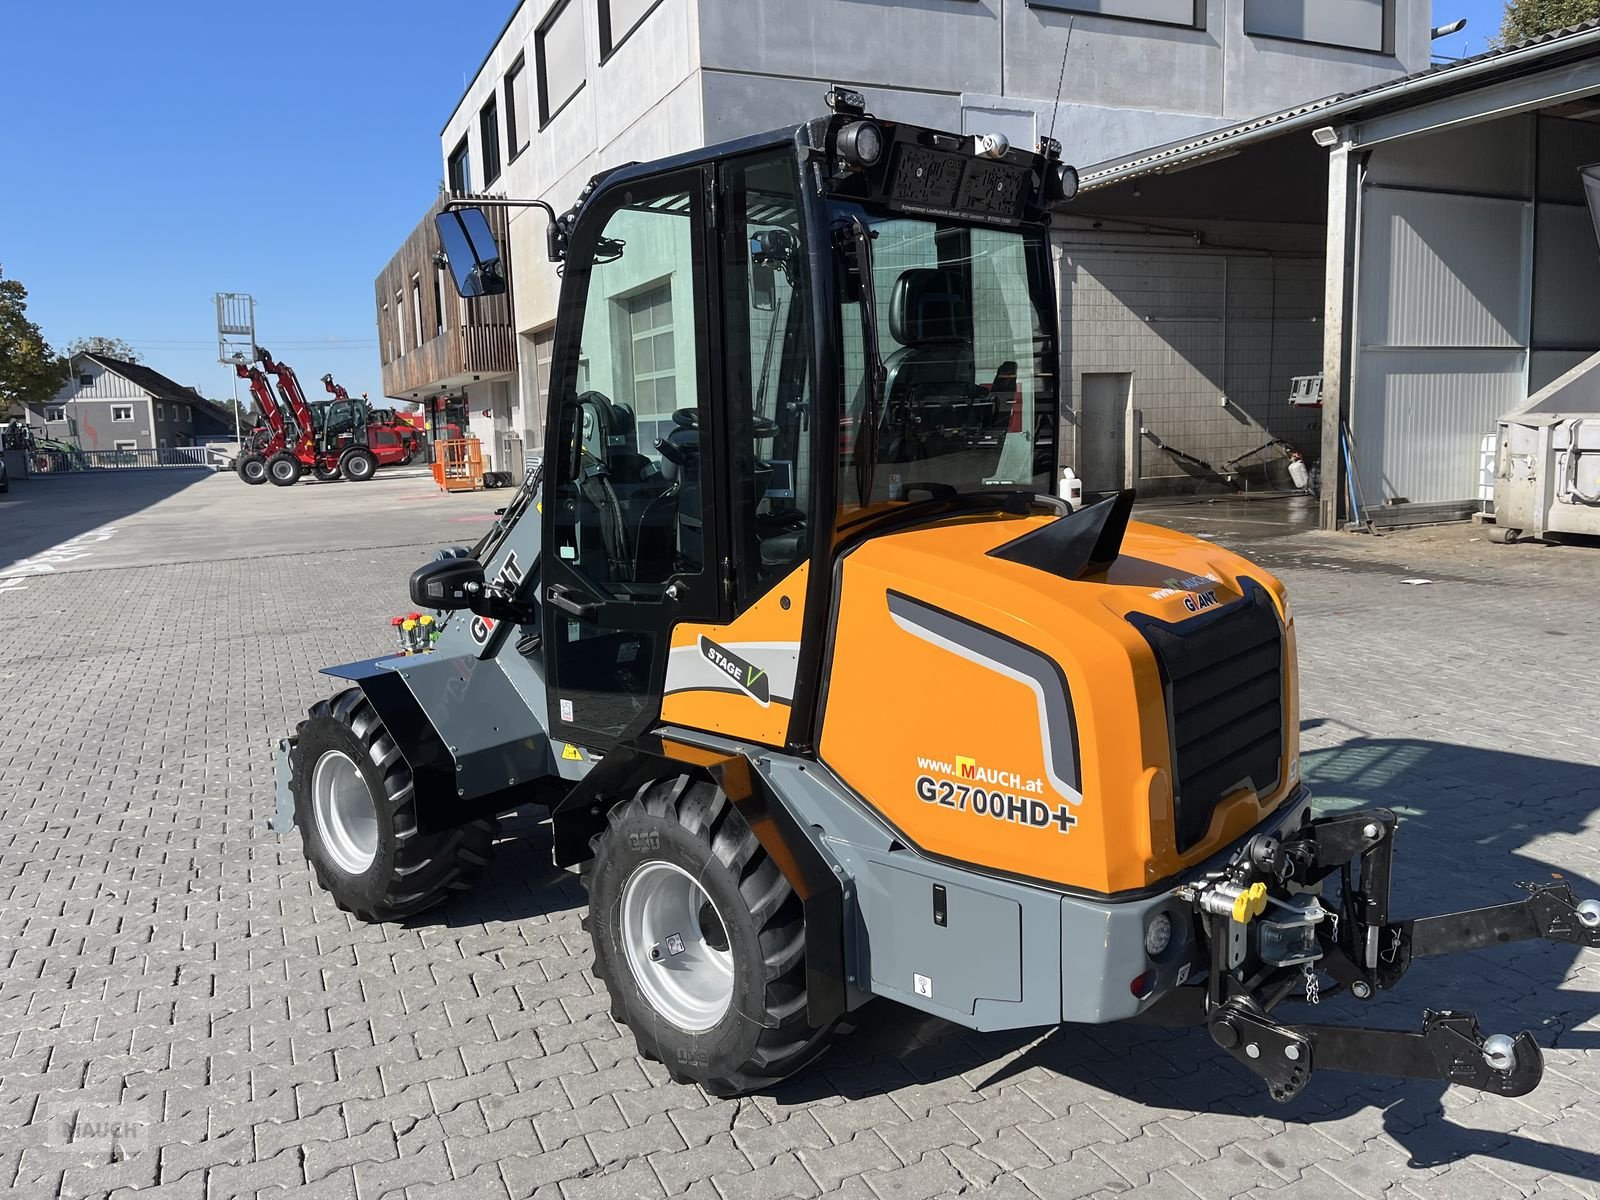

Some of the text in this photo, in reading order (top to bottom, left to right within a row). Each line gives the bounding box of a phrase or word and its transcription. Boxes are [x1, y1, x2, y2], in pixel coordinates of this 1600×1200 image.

[1183, 590, 1218, 612] GIANT
[707, 647, 742, 680] STAGE
[916, 756, 1043, 794] www.MAUCH.at
[915, 775, 1077, 834] G2700HD+
